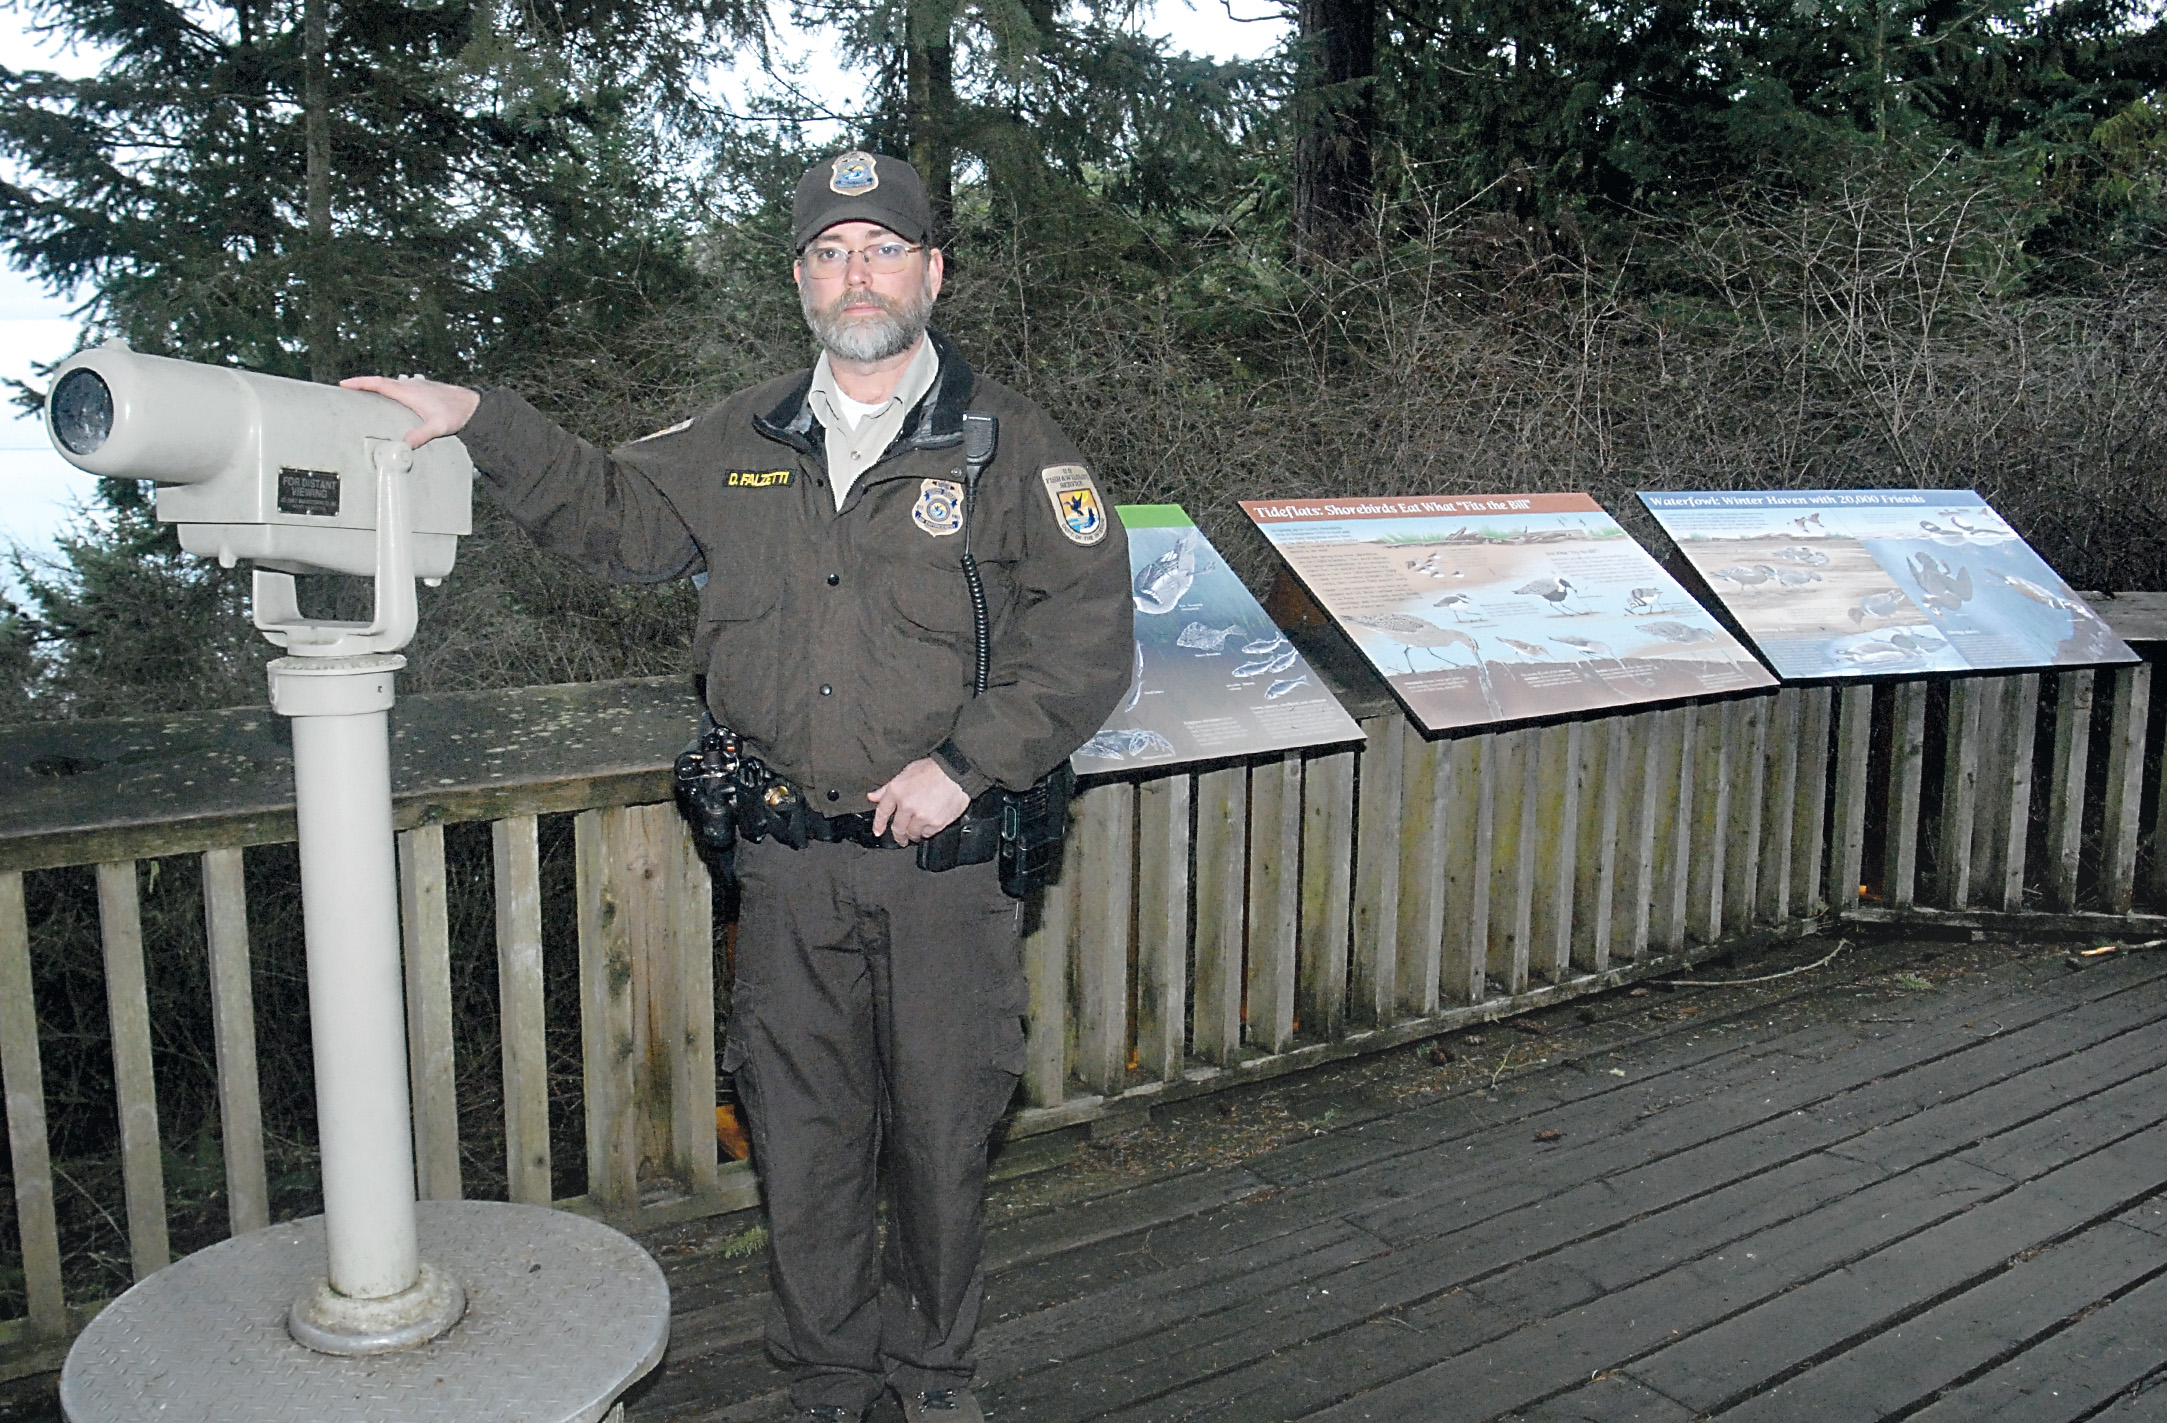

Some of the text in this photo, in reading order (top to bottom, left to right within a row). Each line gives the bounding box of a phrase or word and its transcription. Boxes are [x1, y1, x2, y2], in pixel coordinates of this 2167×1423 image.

[282, 476, 338, 490] FOR DISTANT
[739, 471, 790, 487] FALZETTI
[291, 487, 328, 498] VIEWING
[1649, 494, 1926, 507] Waterfowl: Winter Haven with 20,000 Friends
[1253, 505, 1324, 519] Tideflats:
[1324, 503, 1398, 516] Shorebirds
[1397, 502, 1422, 513] Eat
[1420, 501, 1458, 512] What
[1456, 500, 1487, 511] "Fits
[1486, 499, 1509, 510] the
